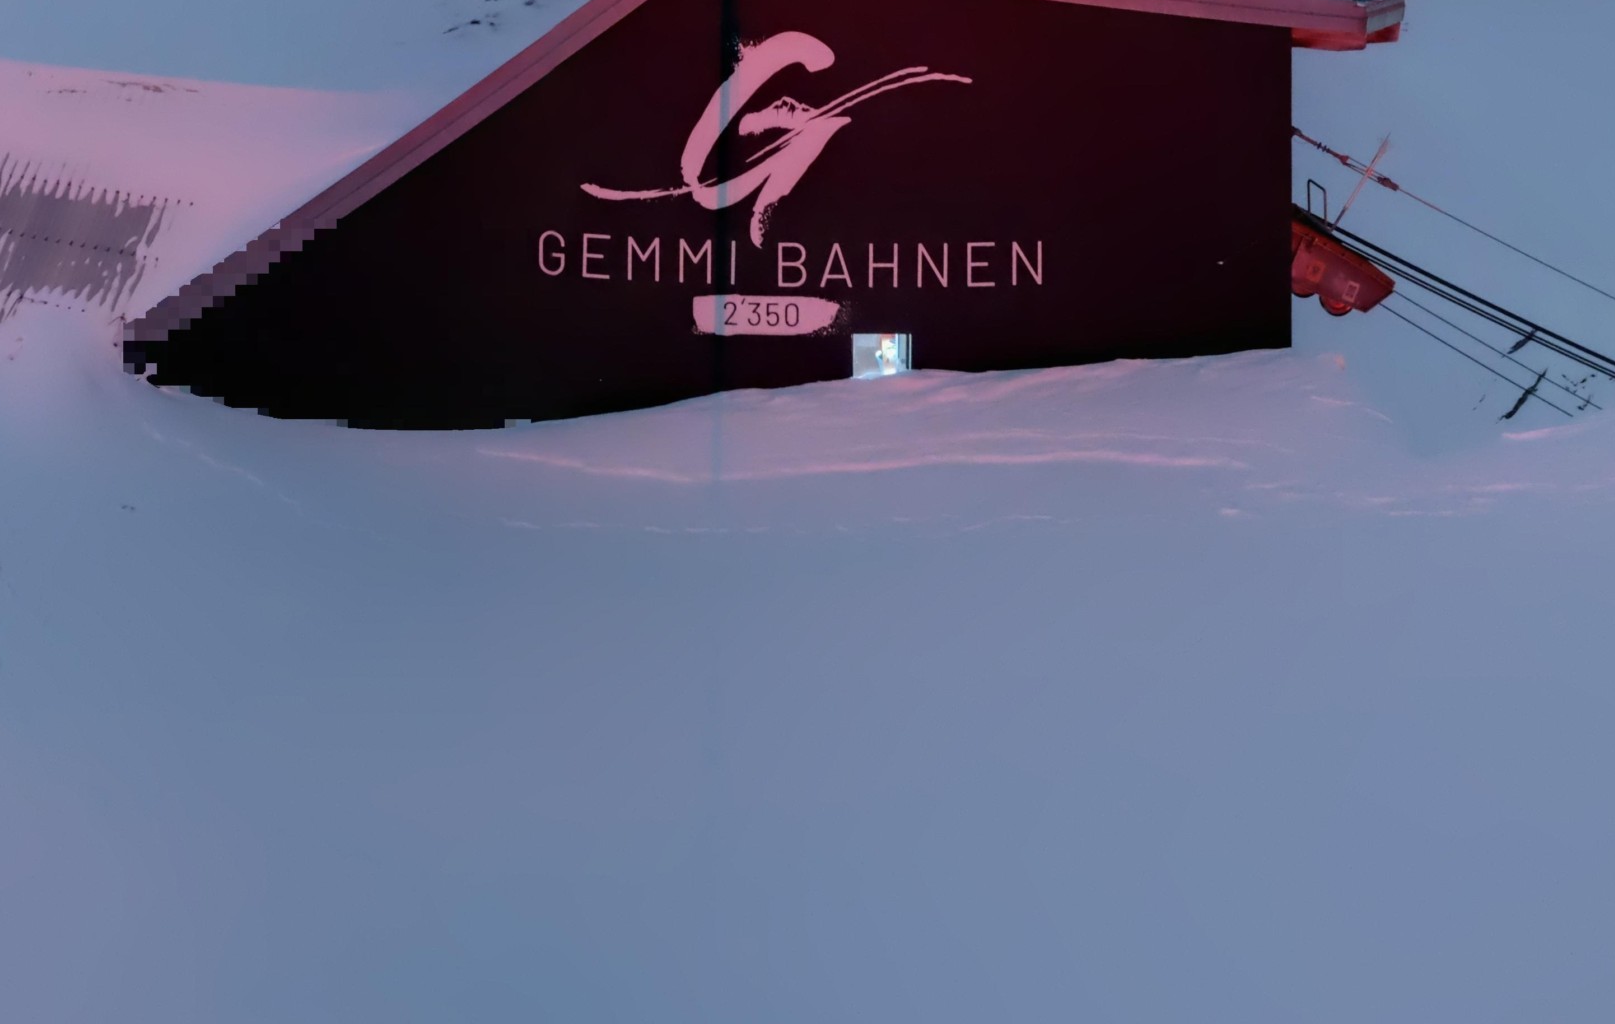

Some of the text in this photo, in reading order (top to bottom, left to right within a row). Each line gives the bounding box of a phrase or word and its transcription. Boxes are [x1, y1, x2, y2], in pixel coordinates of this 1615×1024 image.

[538, 230, 1045, 288] GEMMI BAHNEN
[723, 299, 800, 328] 2'350
